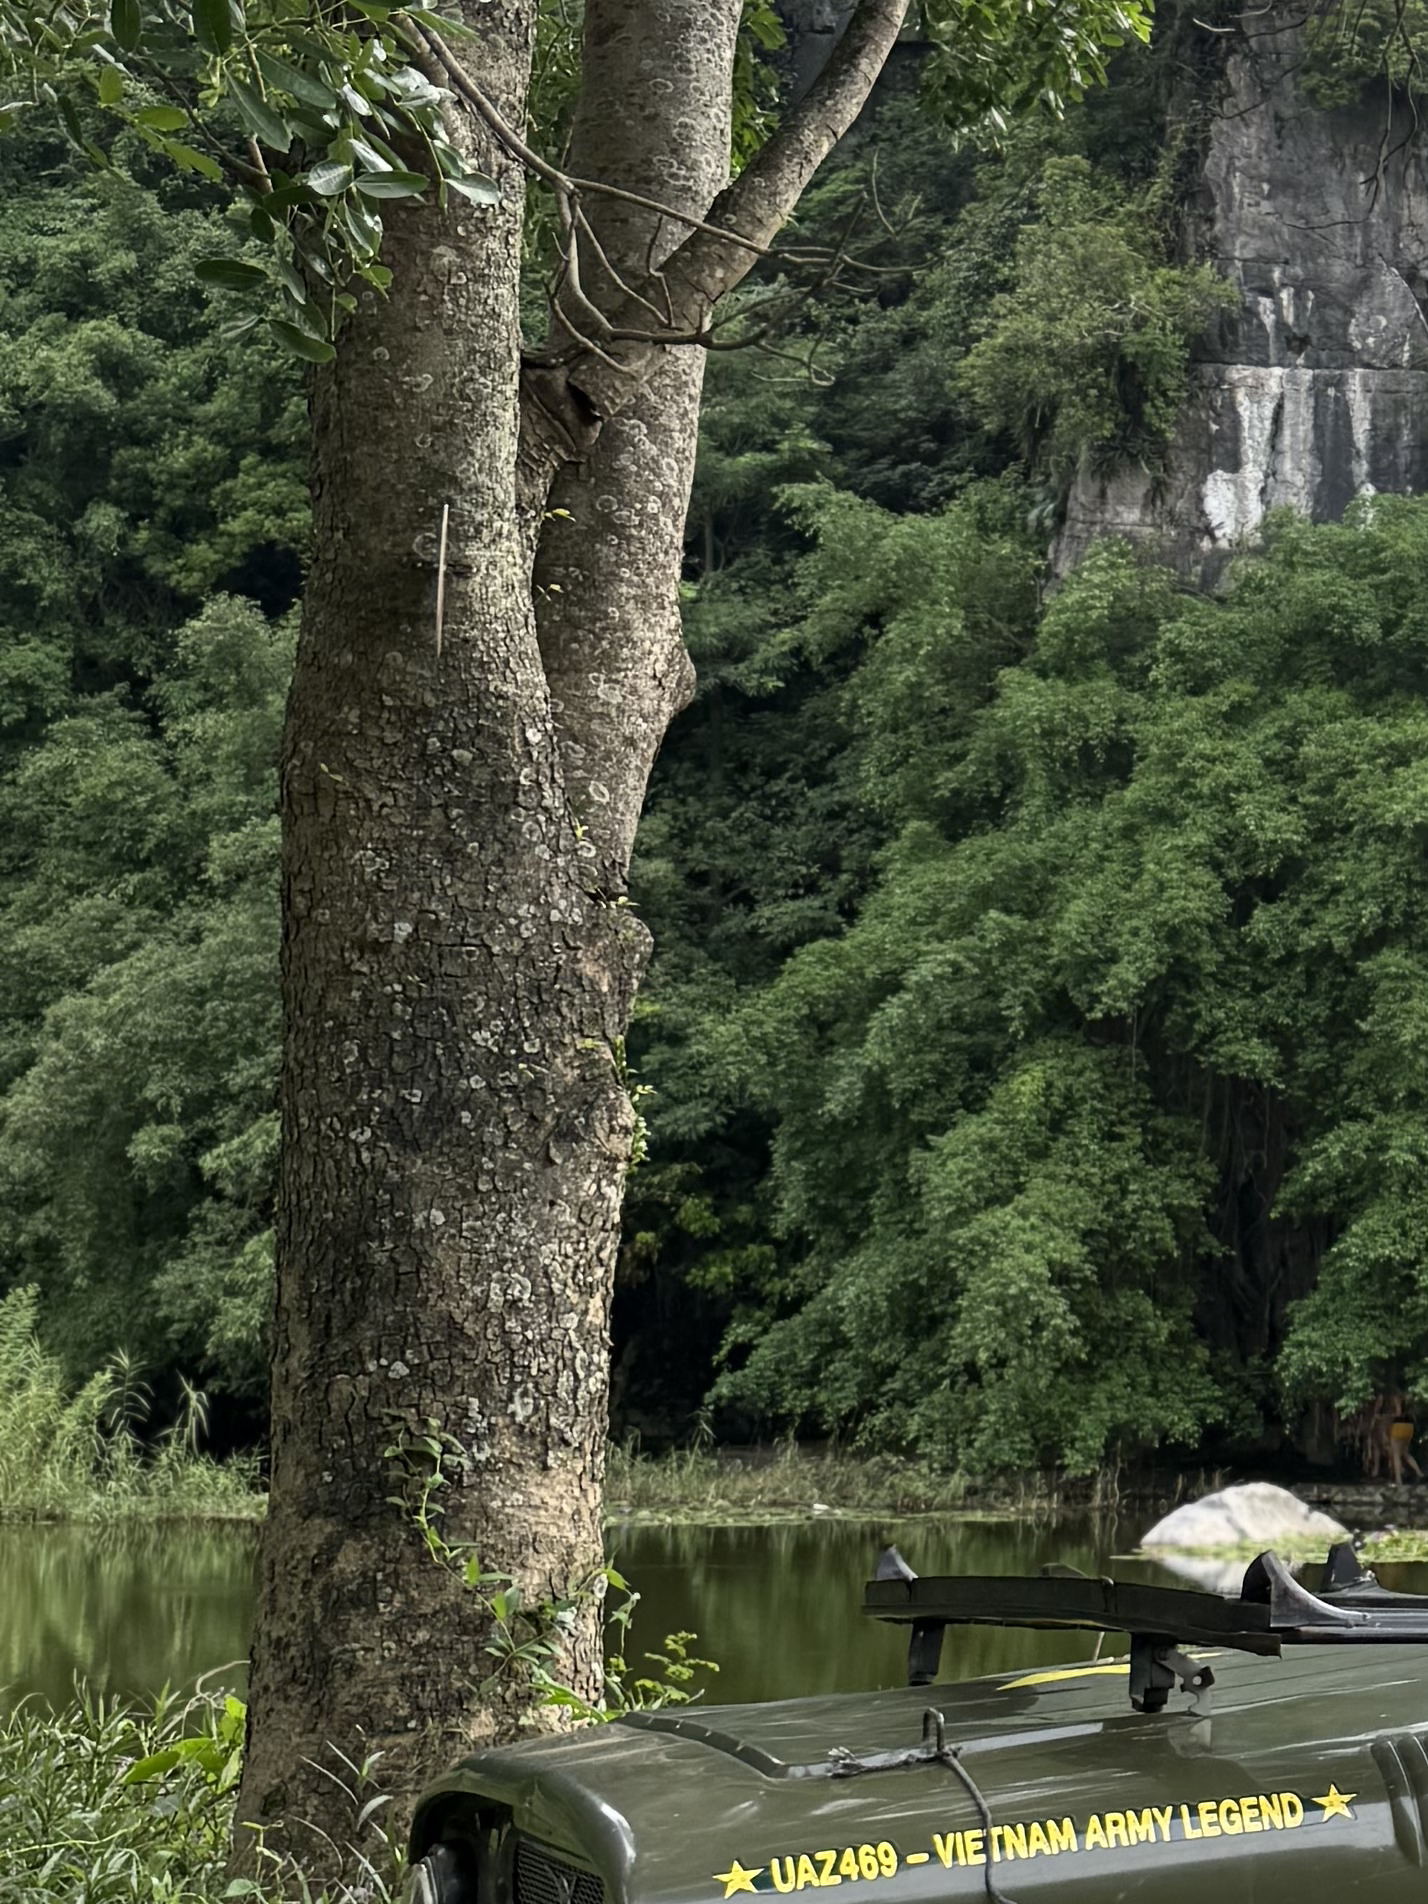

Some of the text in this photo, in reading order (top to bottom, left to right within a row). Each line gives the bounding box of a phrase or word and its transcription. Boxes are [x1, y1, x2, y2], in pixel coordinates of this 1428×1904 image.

[771, 1841, 898, 1893] UAZ469
[933, 1817, 1078, 1868] VIETNAM
[1085, 1805, 1173, 1850] ARMY
[1180, 1792, 1304, 1840] LEGEND
